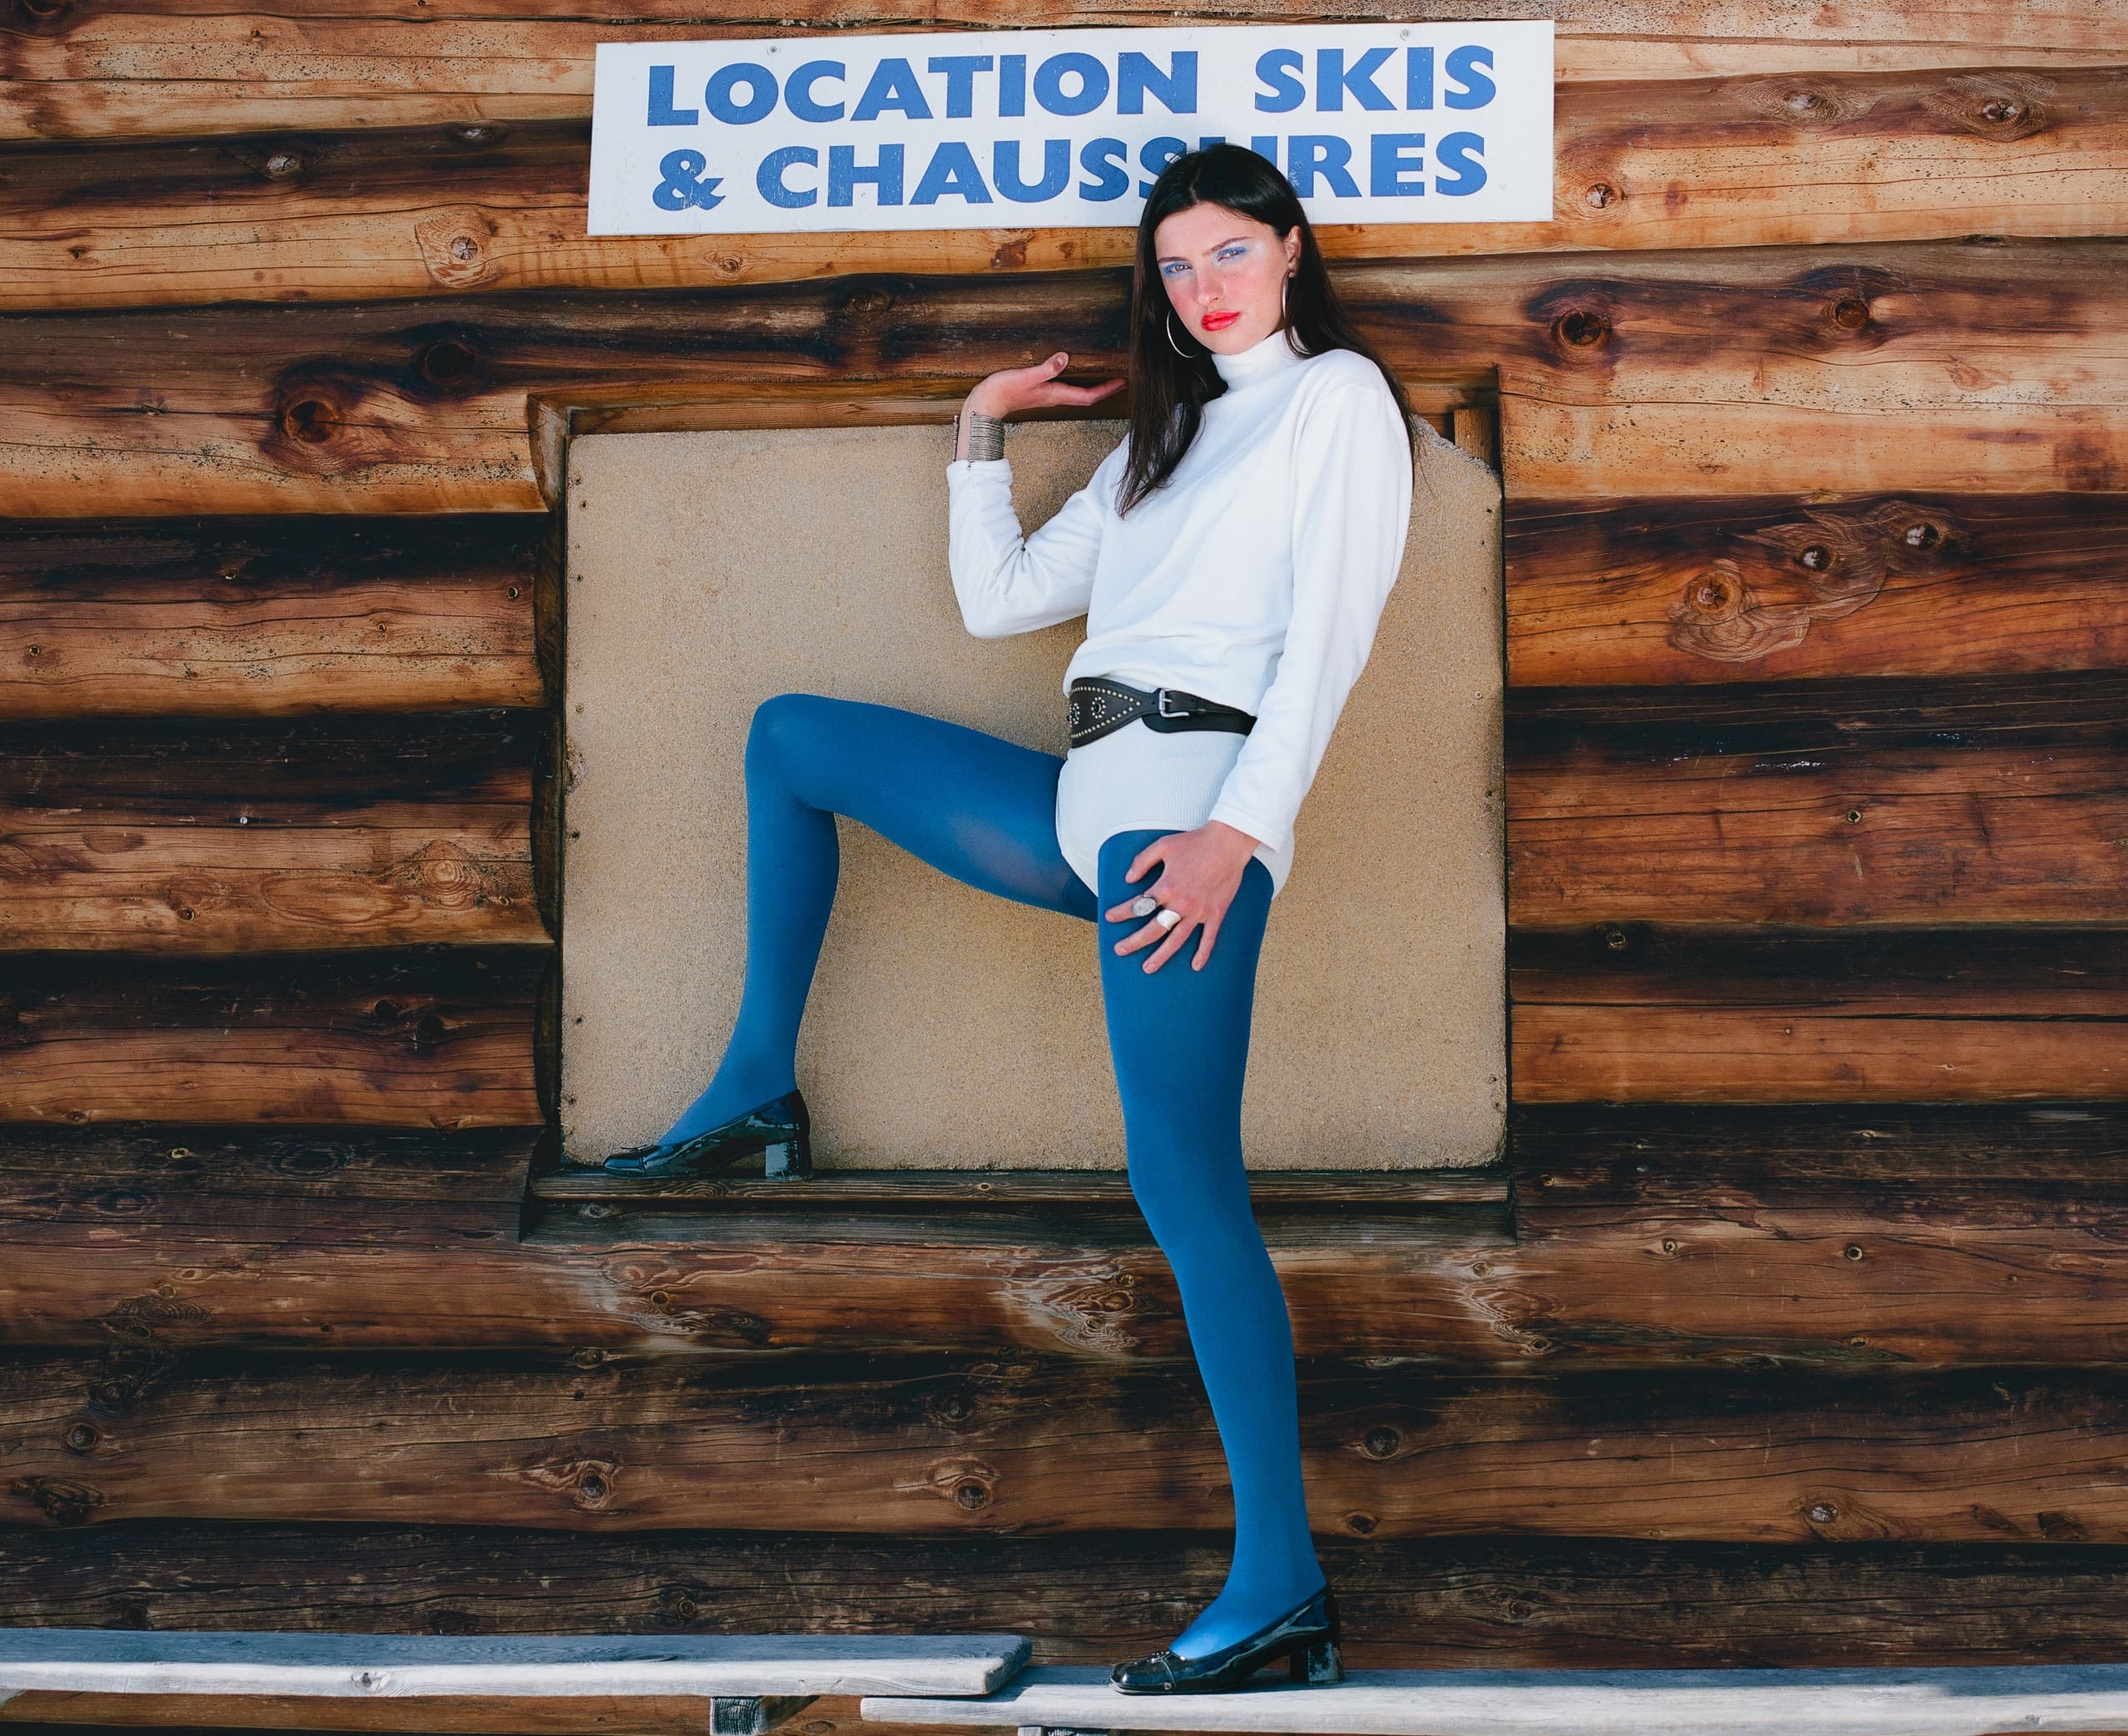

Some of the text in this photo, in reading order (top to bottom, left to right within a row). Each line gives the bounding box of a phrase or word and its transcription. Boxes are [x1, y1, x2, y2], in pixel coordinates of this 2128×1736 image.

[648, 44, 1496, 127] LOCATION SKIS
[652, 131, 1488, 212] & CHAUSSRES
